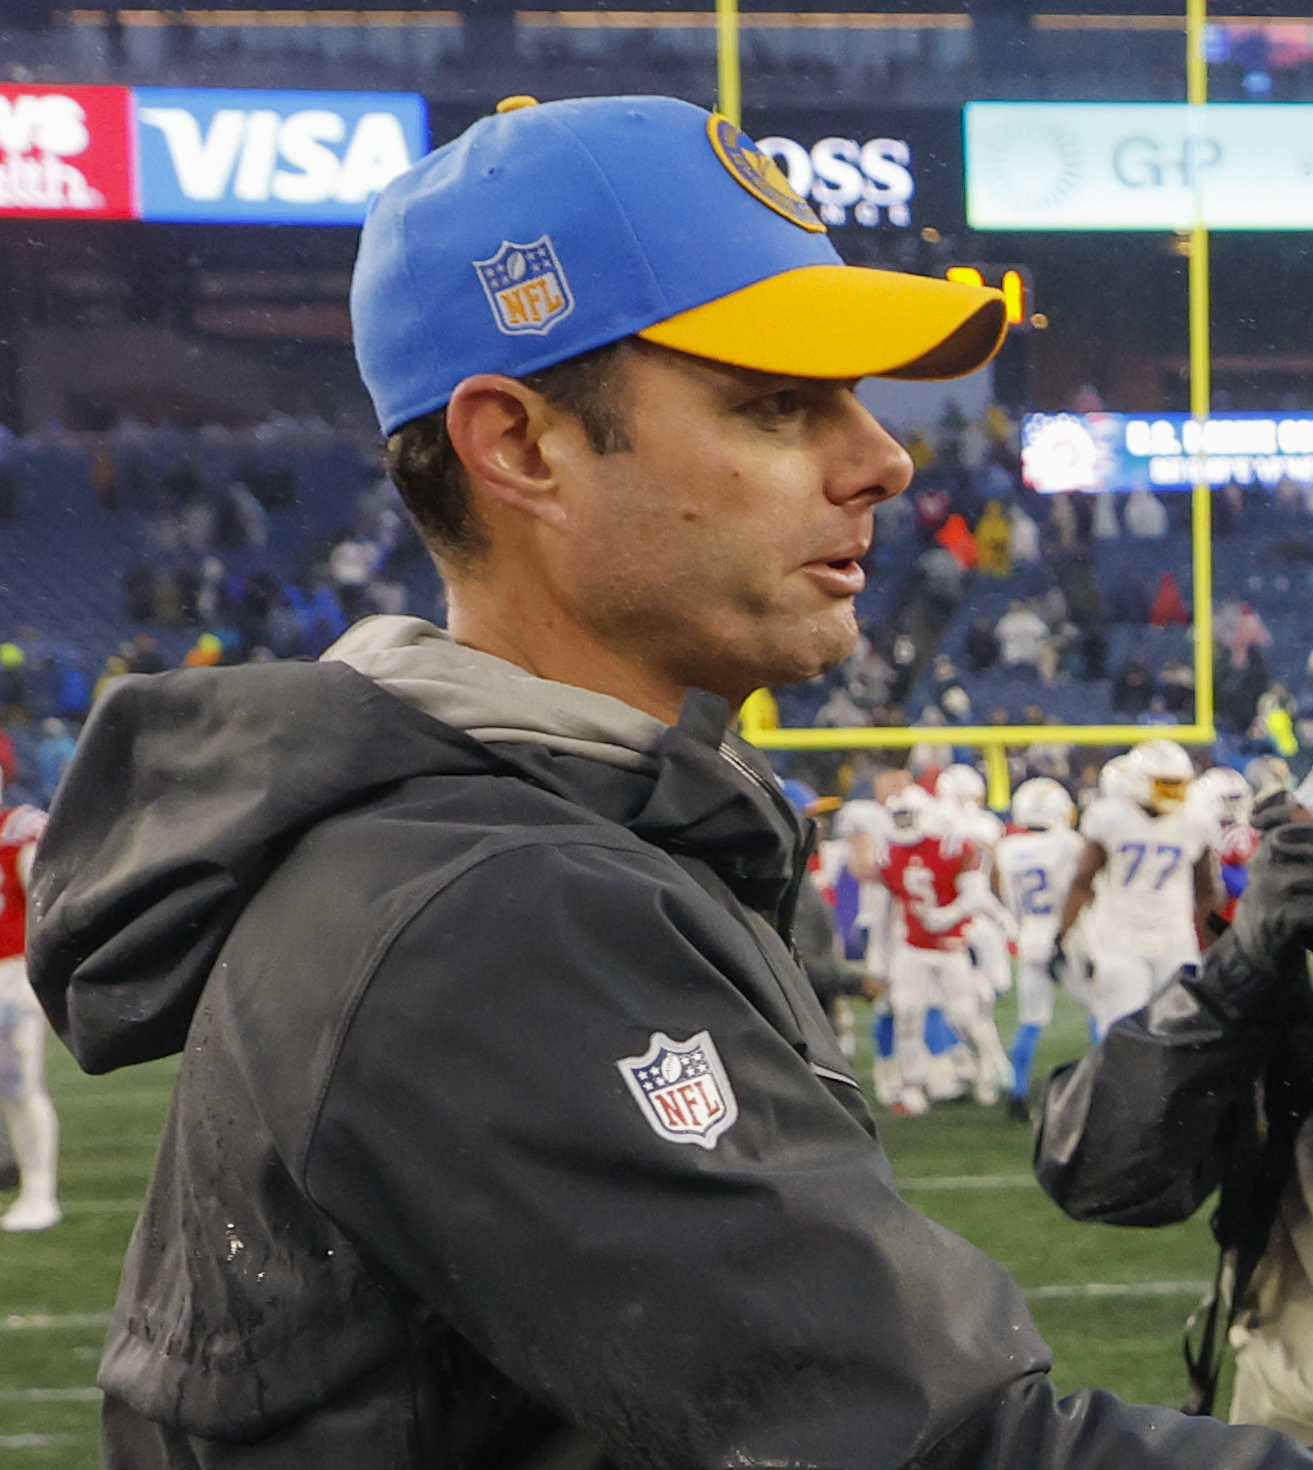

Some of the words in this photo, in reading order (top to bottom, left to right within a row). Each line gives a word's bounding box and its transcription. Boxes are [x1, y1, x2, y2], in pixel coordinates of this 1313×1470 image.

[139, 107, 416, 203] VISA
[501, 279, 563, 326] NFL
[1119, 842, 1182, 891] 77
[655, 1080, 721, 1127] NFL
